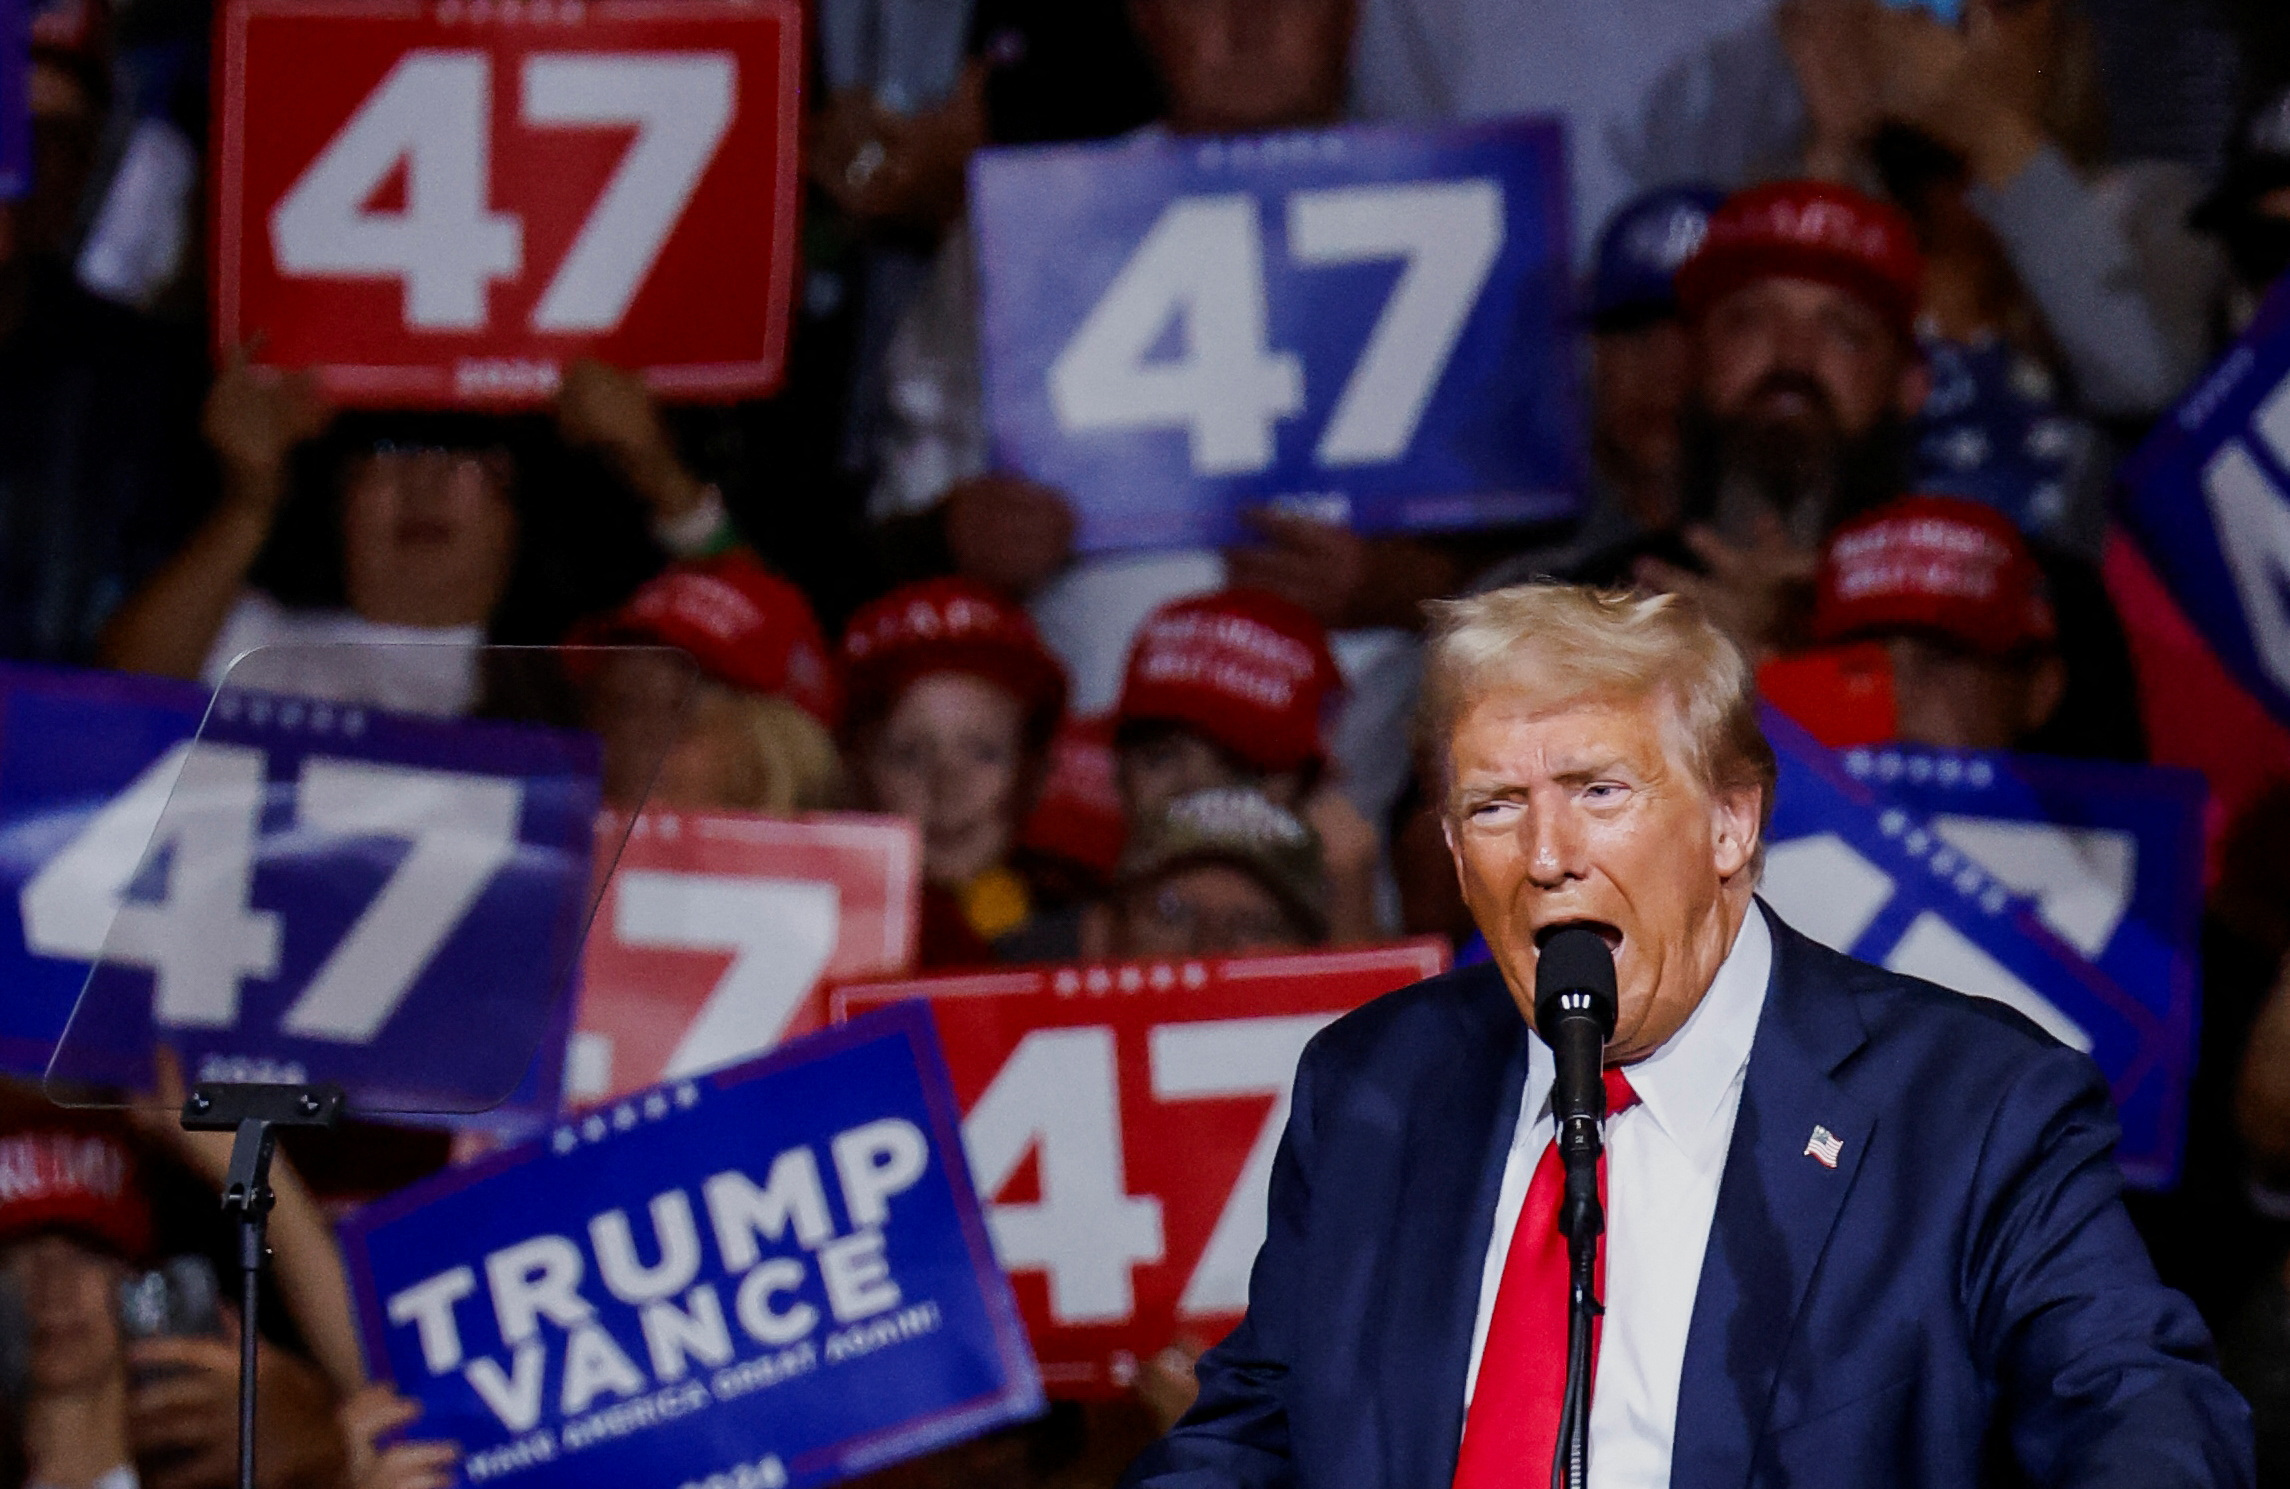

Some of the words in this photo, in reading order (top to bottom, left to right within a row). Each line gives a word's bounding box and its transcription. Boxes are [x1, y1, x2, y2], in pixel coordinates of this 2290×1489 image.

[272, 51, 736, 332] 47
[1048, 178, 1505, 477] 47
[20, 738, 521, 1042] 47
[388, 1117, 930, 1374] TRUMP
[464, 1229, 903, 1433] VANCE
